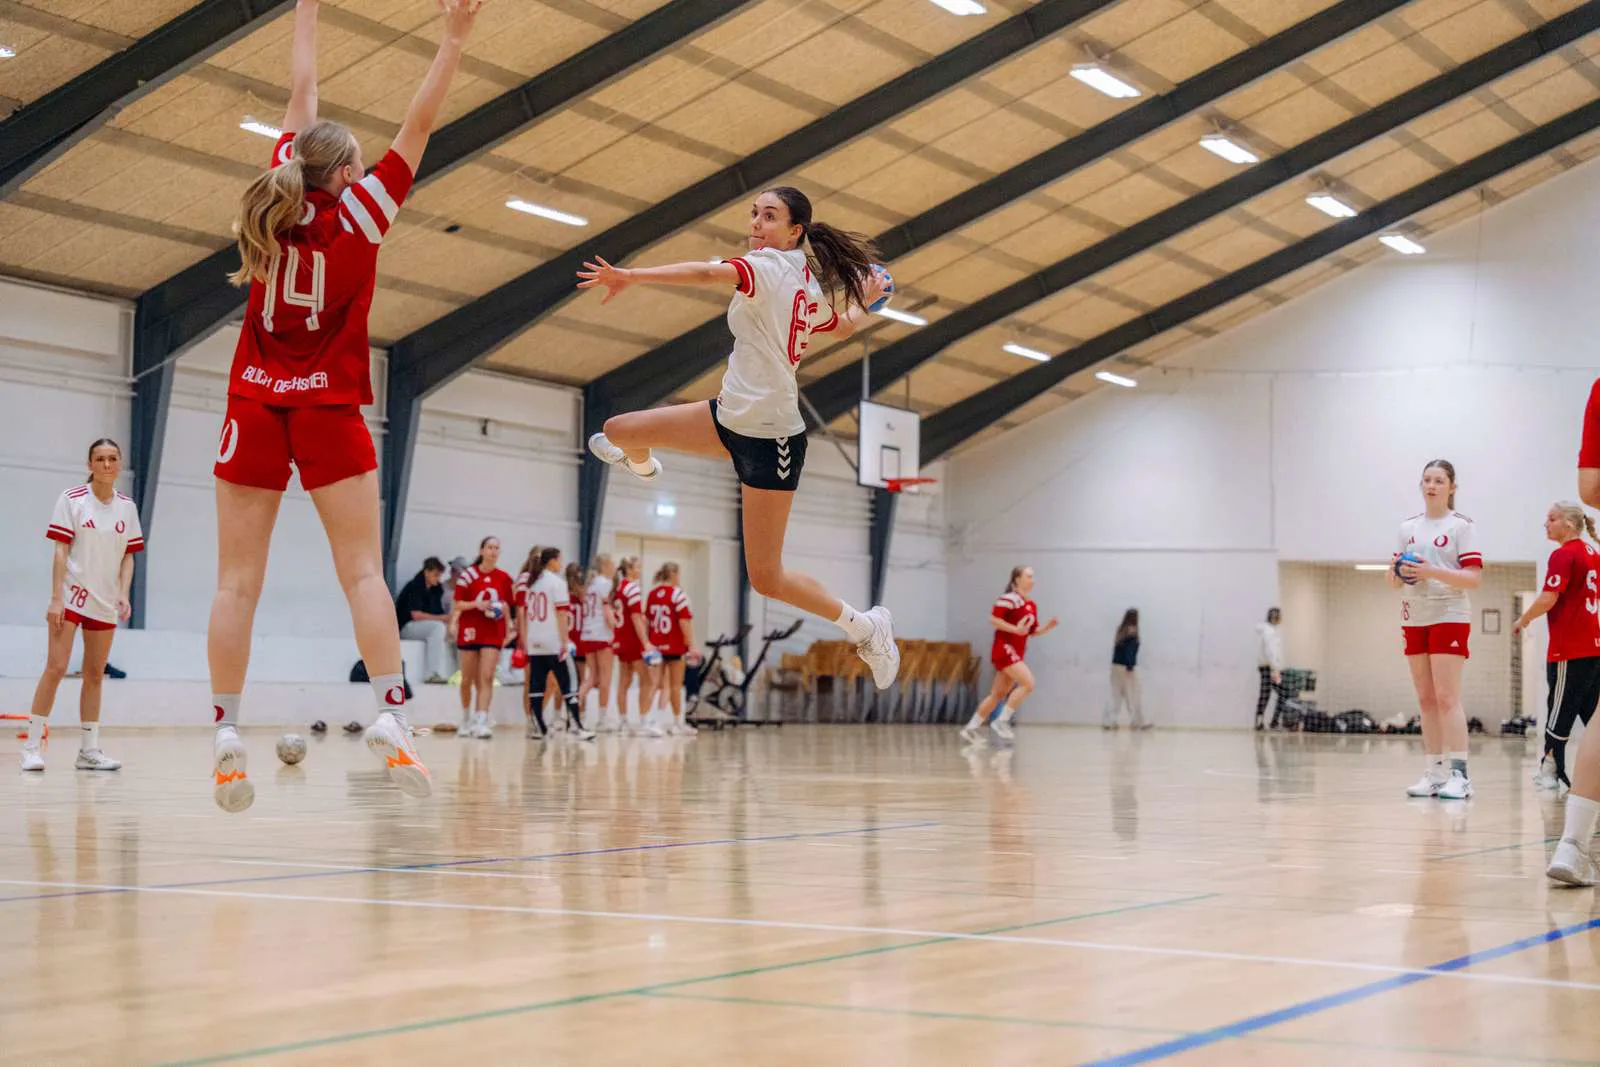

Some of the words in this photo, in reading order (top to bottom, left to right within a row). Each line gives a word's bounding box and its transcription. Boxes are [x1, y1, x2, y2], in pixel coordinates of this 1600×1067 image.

[261, 245, 326, 333] 14
[69, 585, 89, 609] 78
[650, 604, 672, 635] 76
